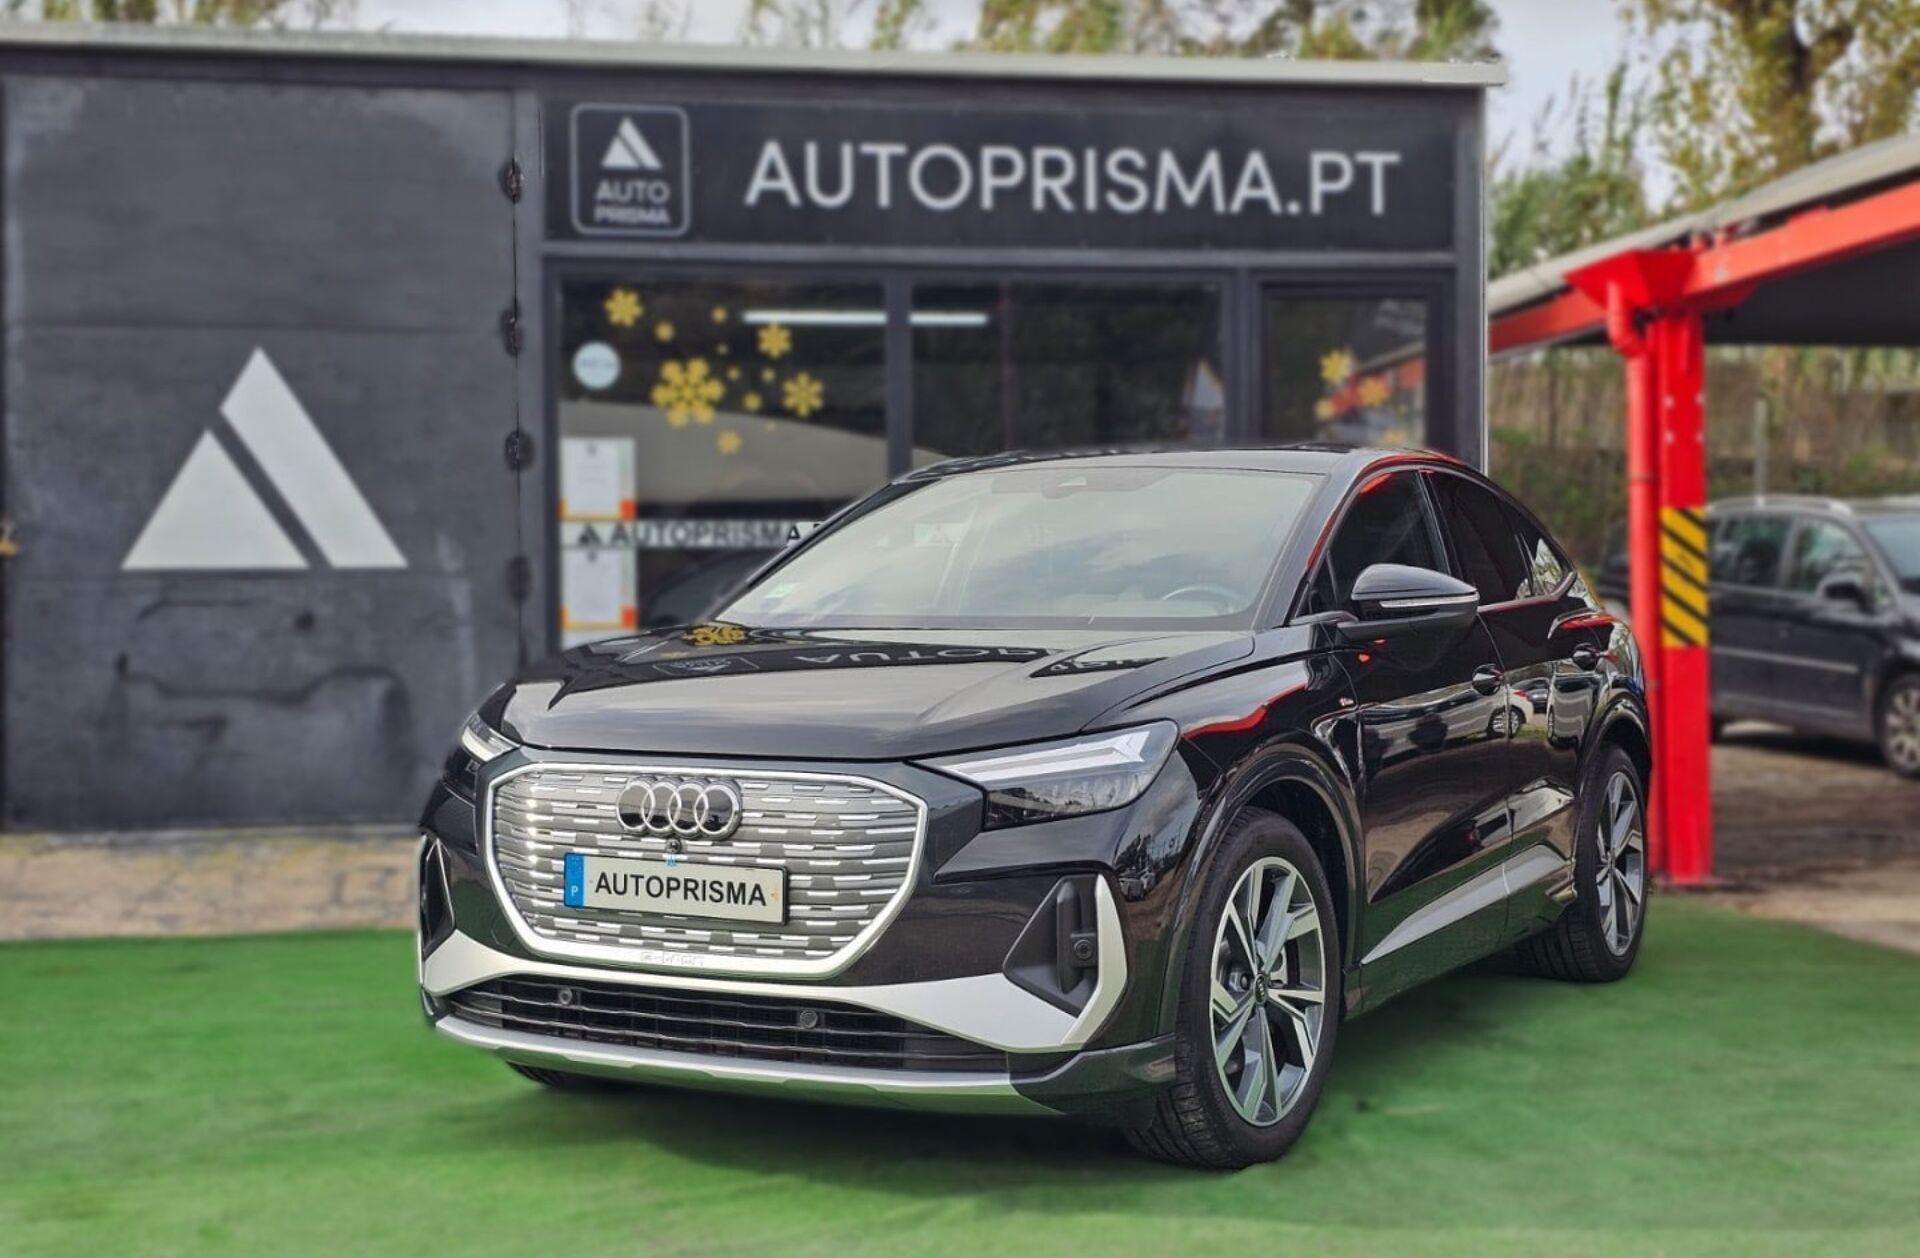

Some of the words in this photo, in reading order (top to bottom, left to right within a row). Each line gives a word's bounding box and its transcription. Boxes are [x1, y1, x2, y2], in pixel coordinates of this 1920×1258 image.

[744, 140, 1400, 216] AUTOPRISMA.PT
[596, 179, 670, 204] AUTO
[594, 206, 670, 224] PRISMA
[610, 522, 821, 545] AUTOPRISMA
[570, 885, 579, 896] P
[595, 872, 767, 906] AUTOPRISMA
